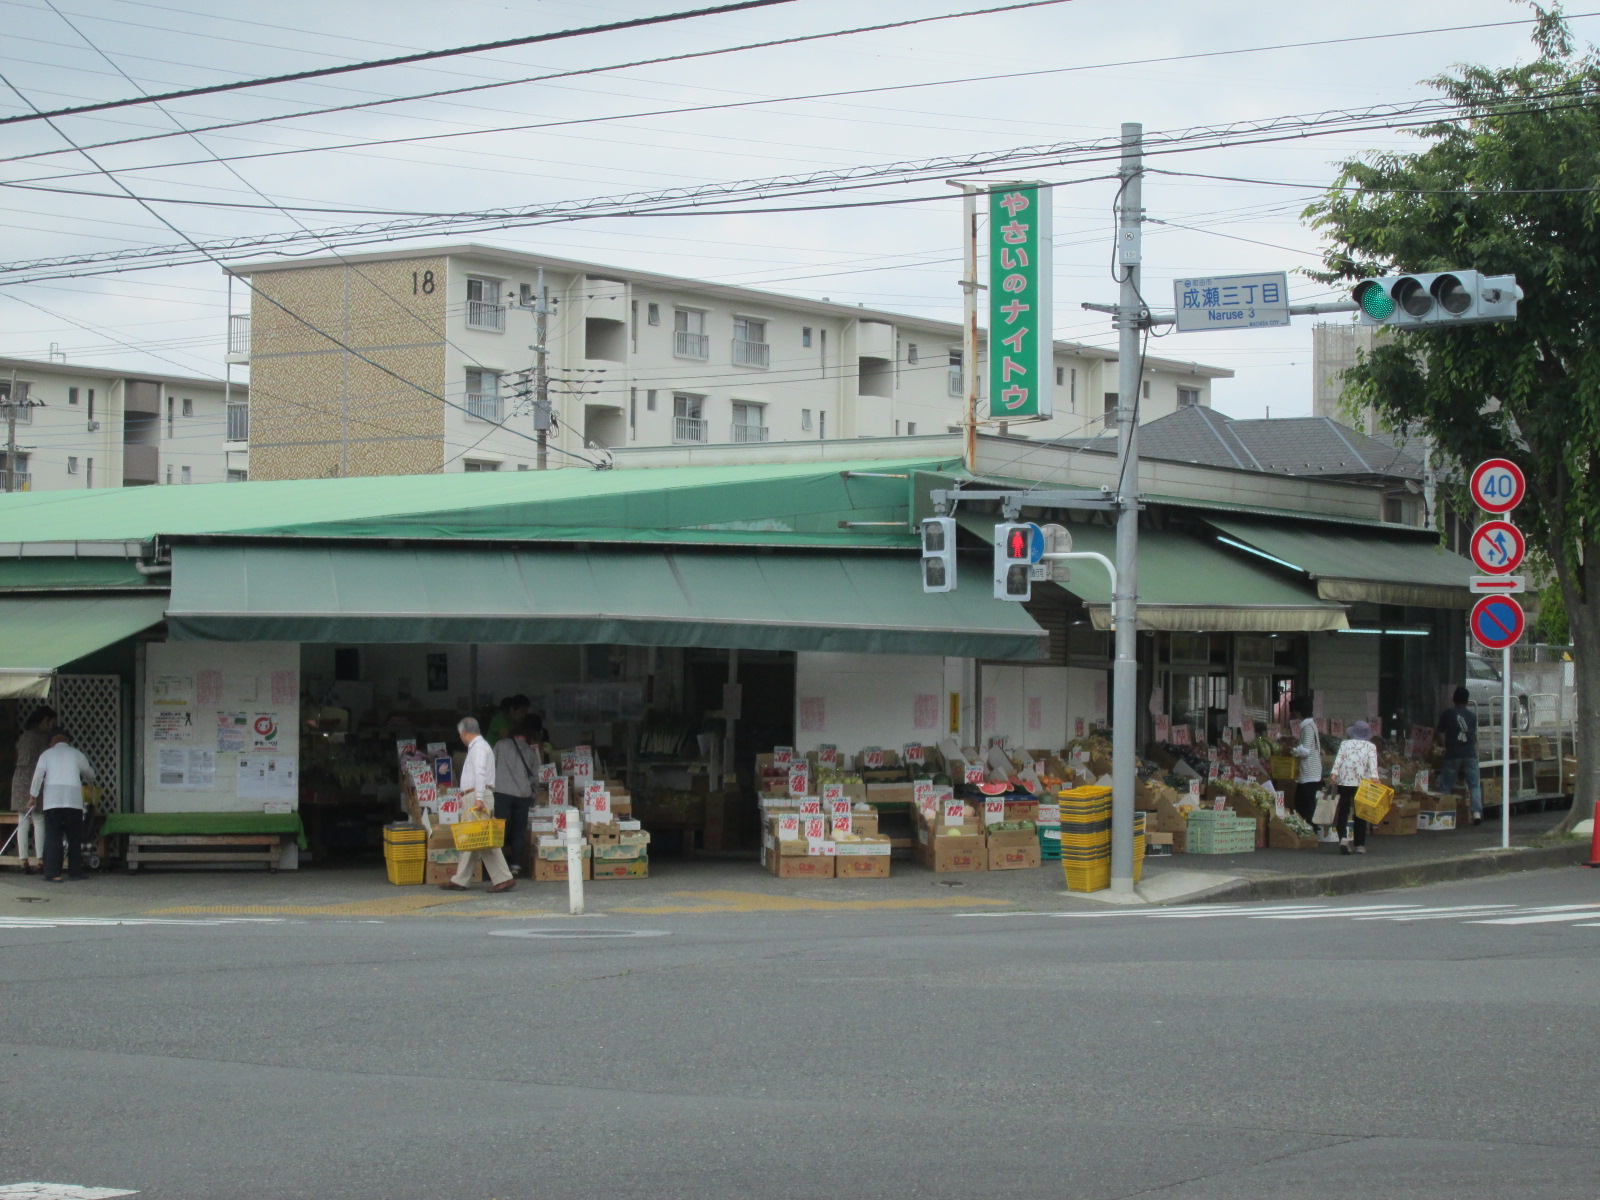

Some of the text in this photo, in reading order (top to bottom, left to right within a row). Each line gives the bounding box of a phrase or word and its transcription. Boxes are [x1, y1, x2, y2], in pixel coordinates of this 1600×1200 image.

[412, 270, 434, 294] 18
[1000, 192, 1029, 410] やさいのナイトウ
[1183, 283, 1279, 309] 成瀬三丁目
[1208, 307, 1256, 321] Naruse 3
[1483, 475, 1513, 498] 40
